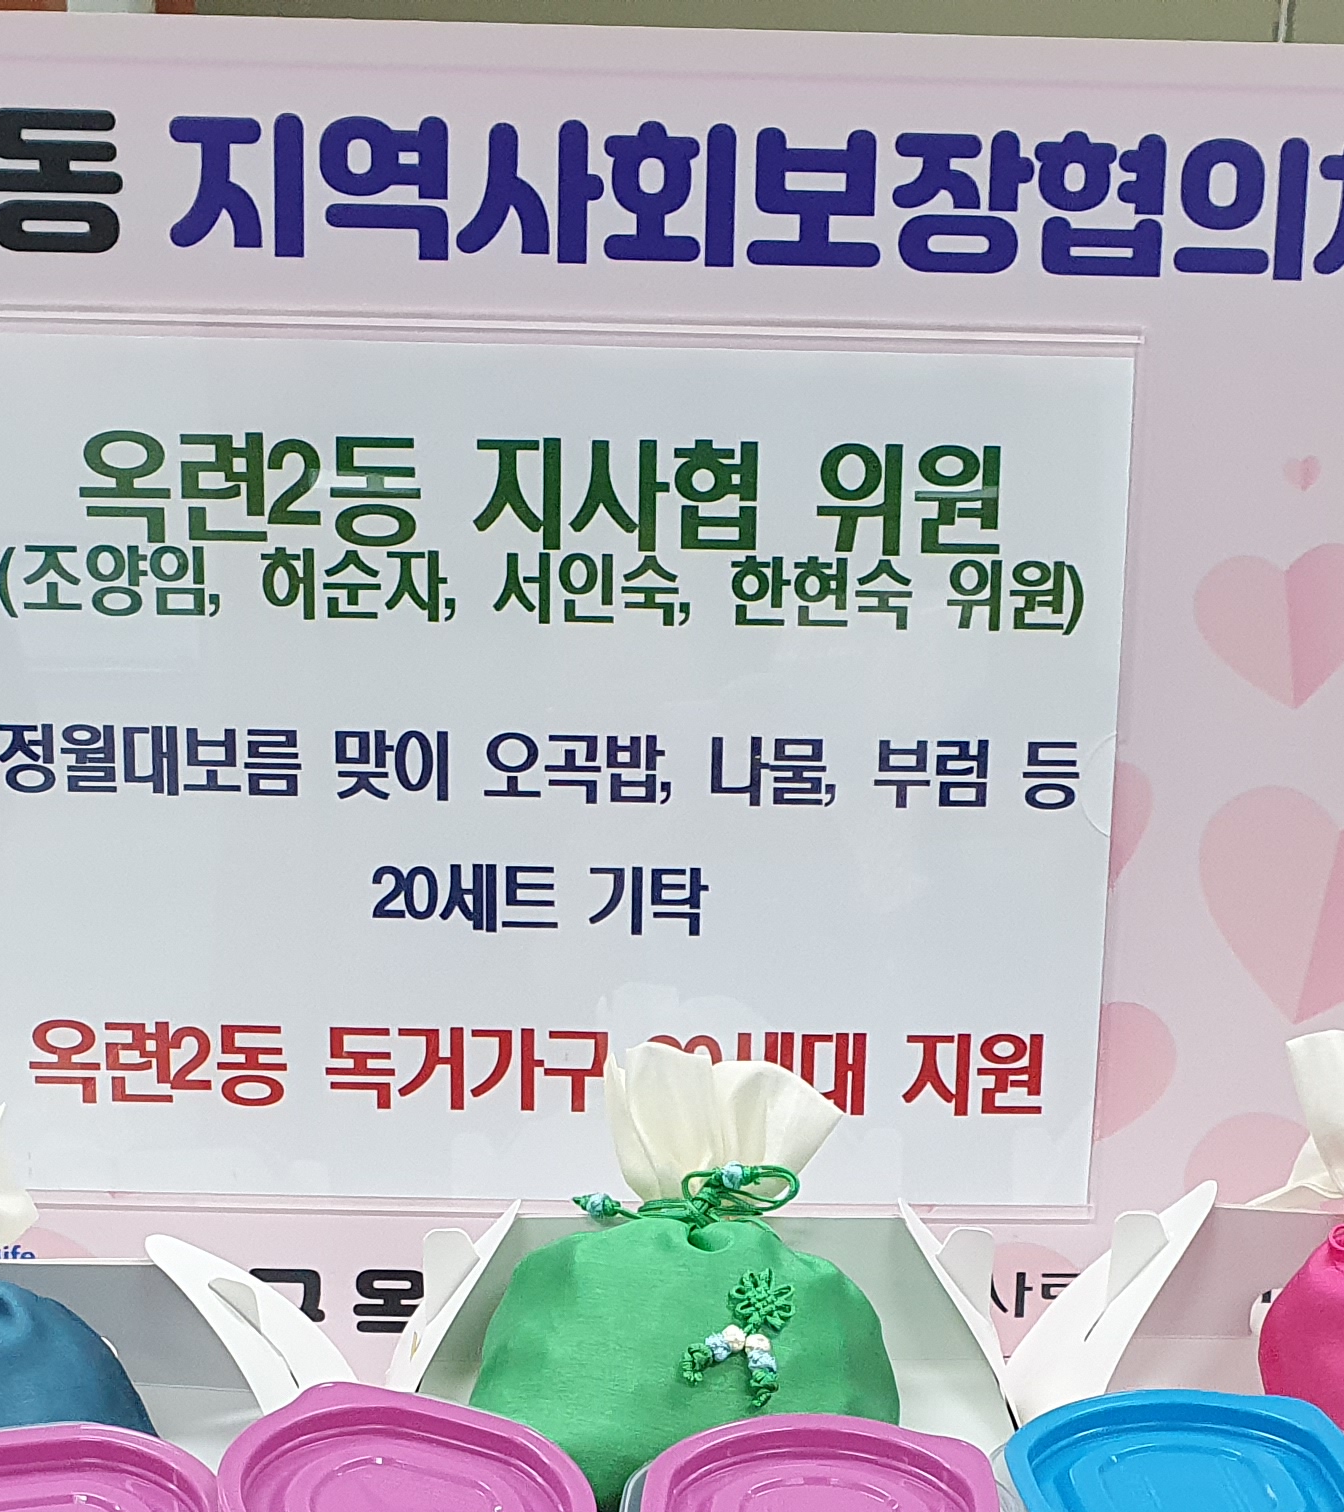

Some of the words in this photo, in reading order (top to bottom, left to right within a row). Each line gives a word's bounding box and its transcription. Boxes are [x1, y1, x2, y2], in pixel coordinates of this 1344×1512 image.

[78, 431, 421, 547] 옥련2동
[475, 438, 758, 552] 지사협
[818, 443, 1001, 556] 위원
[262, 548, 455, 622] 허순자,
[494, 553, 690, 626] 서인숙,
[731, 556, 912, 628] 한현숙
[946, 557, 1084, 636] 위원)
[0, 724, 301, 797] 정월대보름
[335, 730, 448, 802] 맞이
[484, 732, 671, 806] 오곡밥,
[711, 736, 835, 808] 나물,
[874, 739, 990, 810] 부럼
[1022, 741, 1080, 810] 등
[371, 863, 559, 933] 20세트
[588, 867, 709, 937] 기탁
[30, 1019, 288, 1108] 옥련2동
[326, 1027, 609, 1113] 독거가구
[902, 1034, 1045, 1118] 지원
